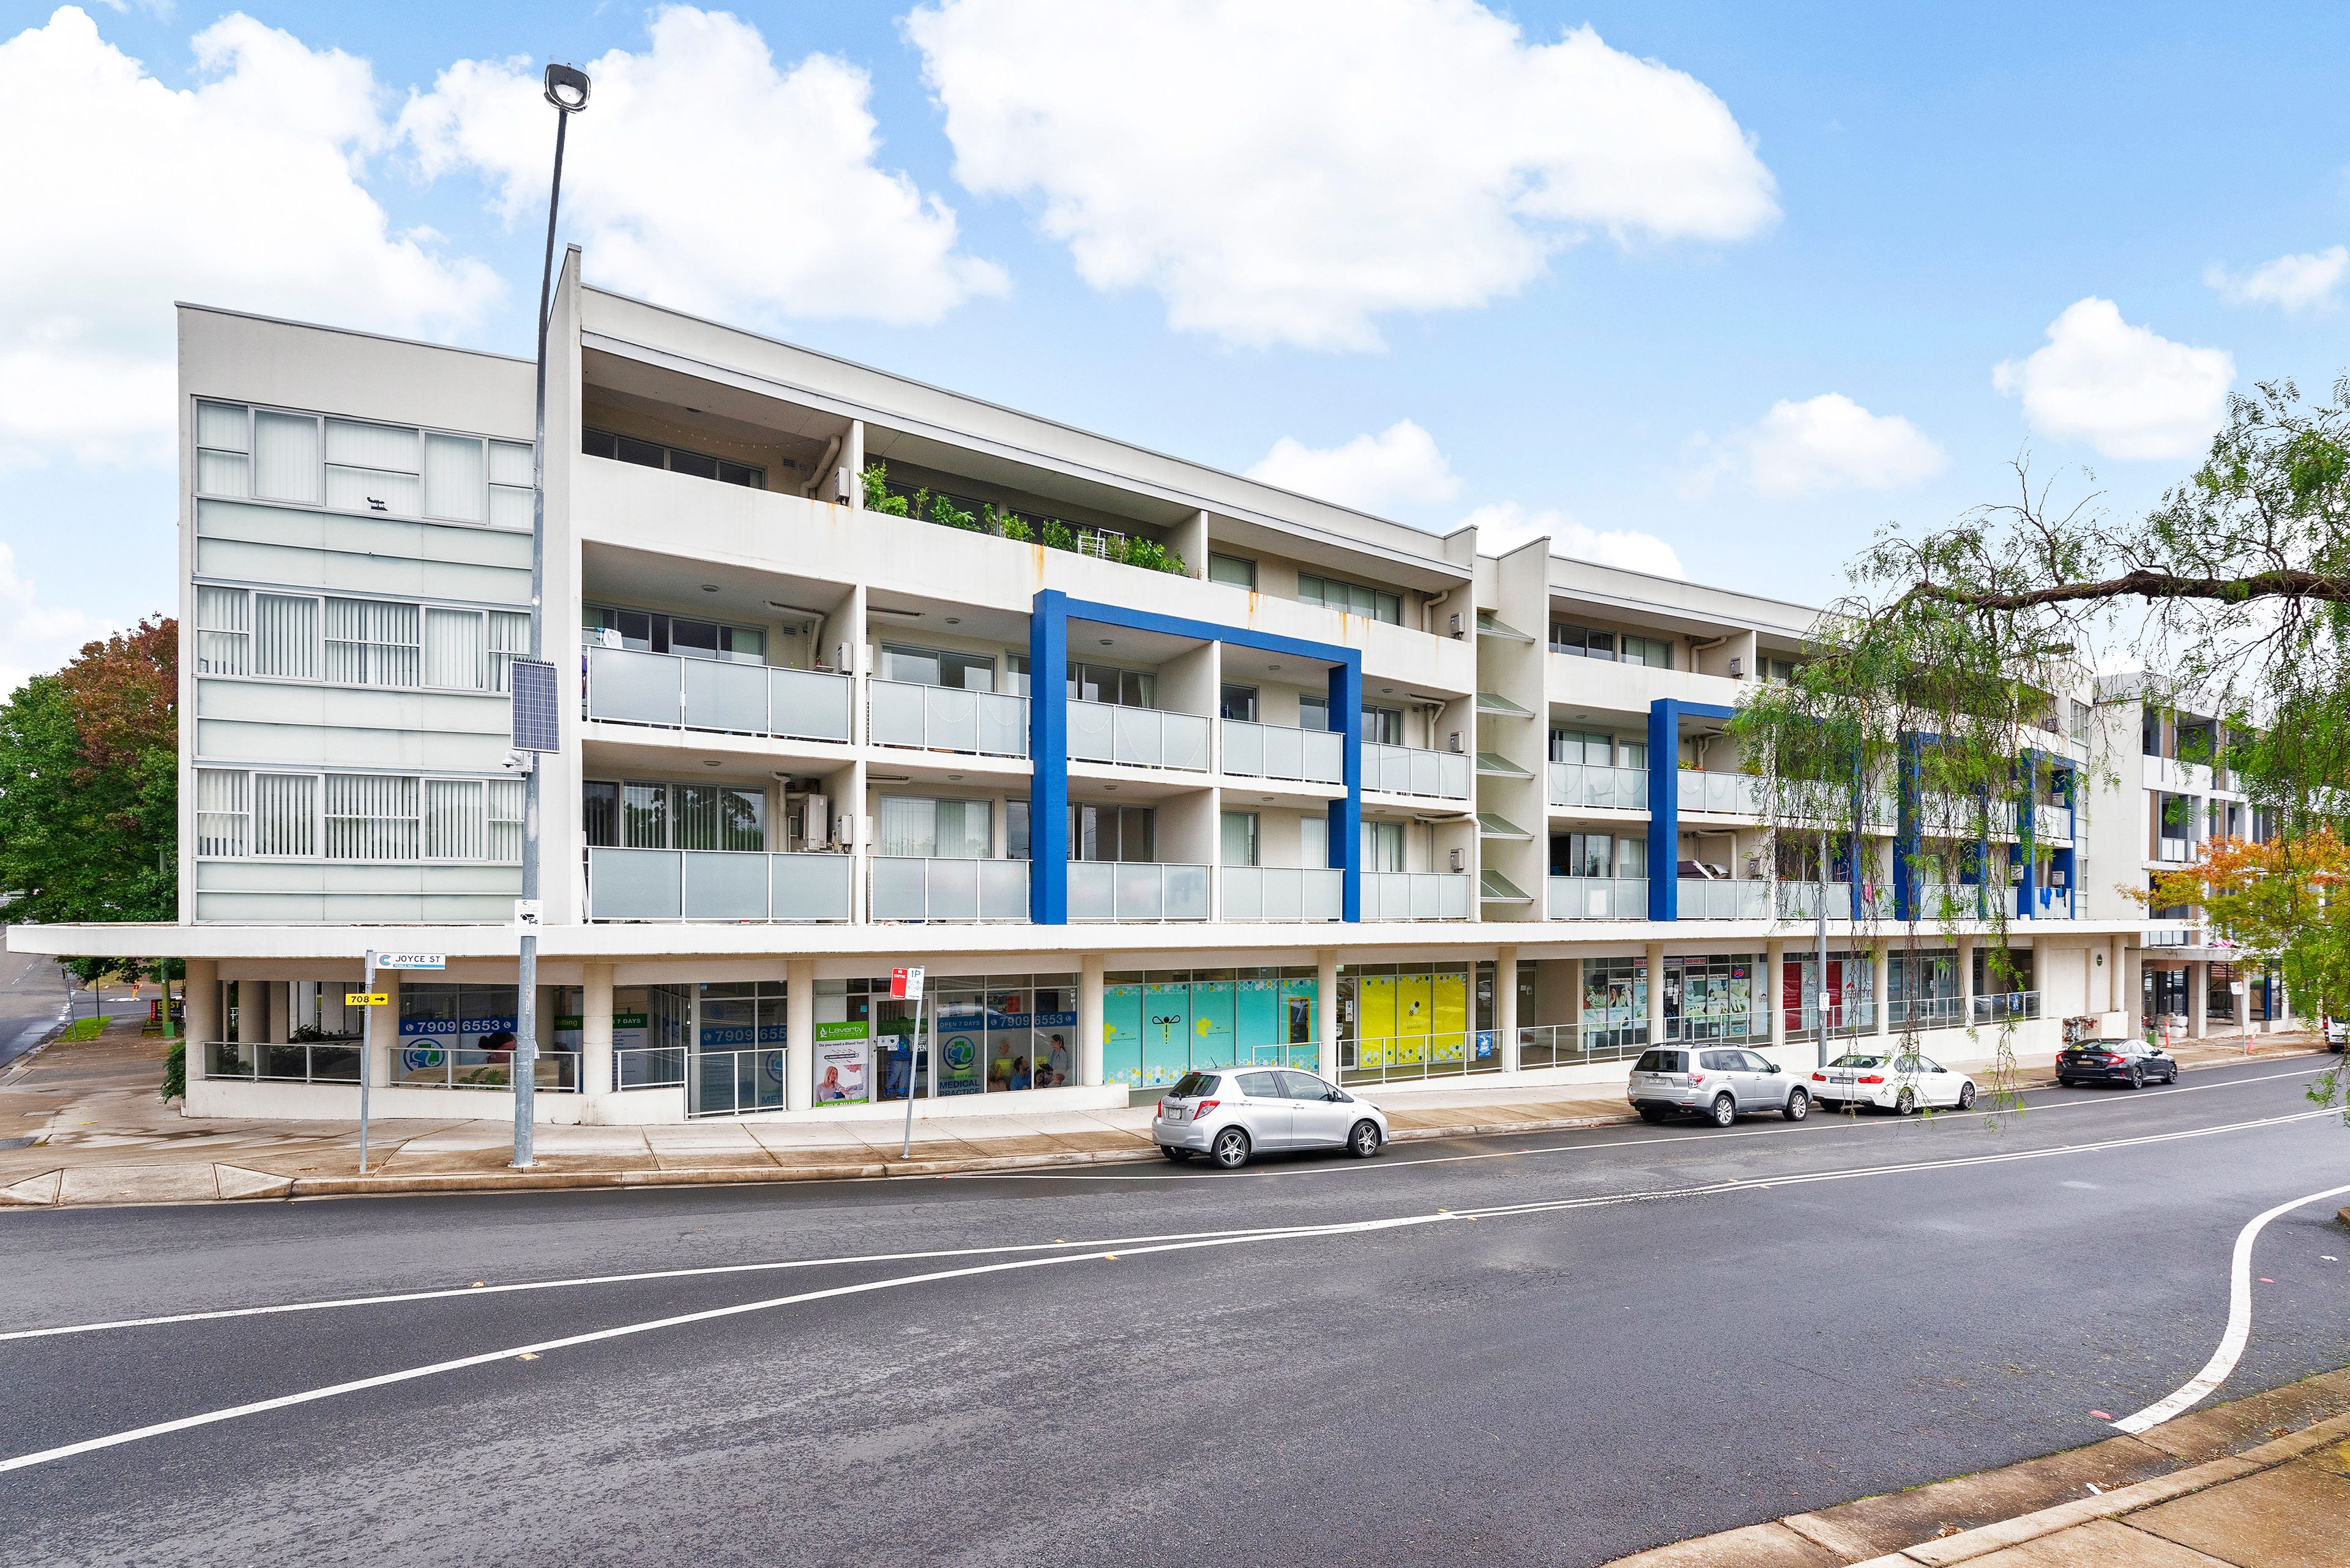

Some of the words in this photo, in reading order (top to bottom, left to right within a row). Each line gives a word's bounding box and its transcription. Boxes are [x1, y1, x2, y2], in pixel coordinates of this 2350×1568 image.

[157, 1001, 181, 1009] BST
[554, 1018, 578, 1027] Billing
[999, 1016, 1030, 1028] 7909
[1035, 1014, 1064, 1026] 6553
[417, 1021, 456, 1032] 7909
[462, 1020, 501, 1031] 6553
[829, 1025, 864, 1034] Laverty
[715, 1029, 753, 1042] 7909
[759, 1028, 786, 1040] 655
[939, 1079, 980, 1089] MEDICAL
[939, 1088, 980, 1096] PRACTICE
